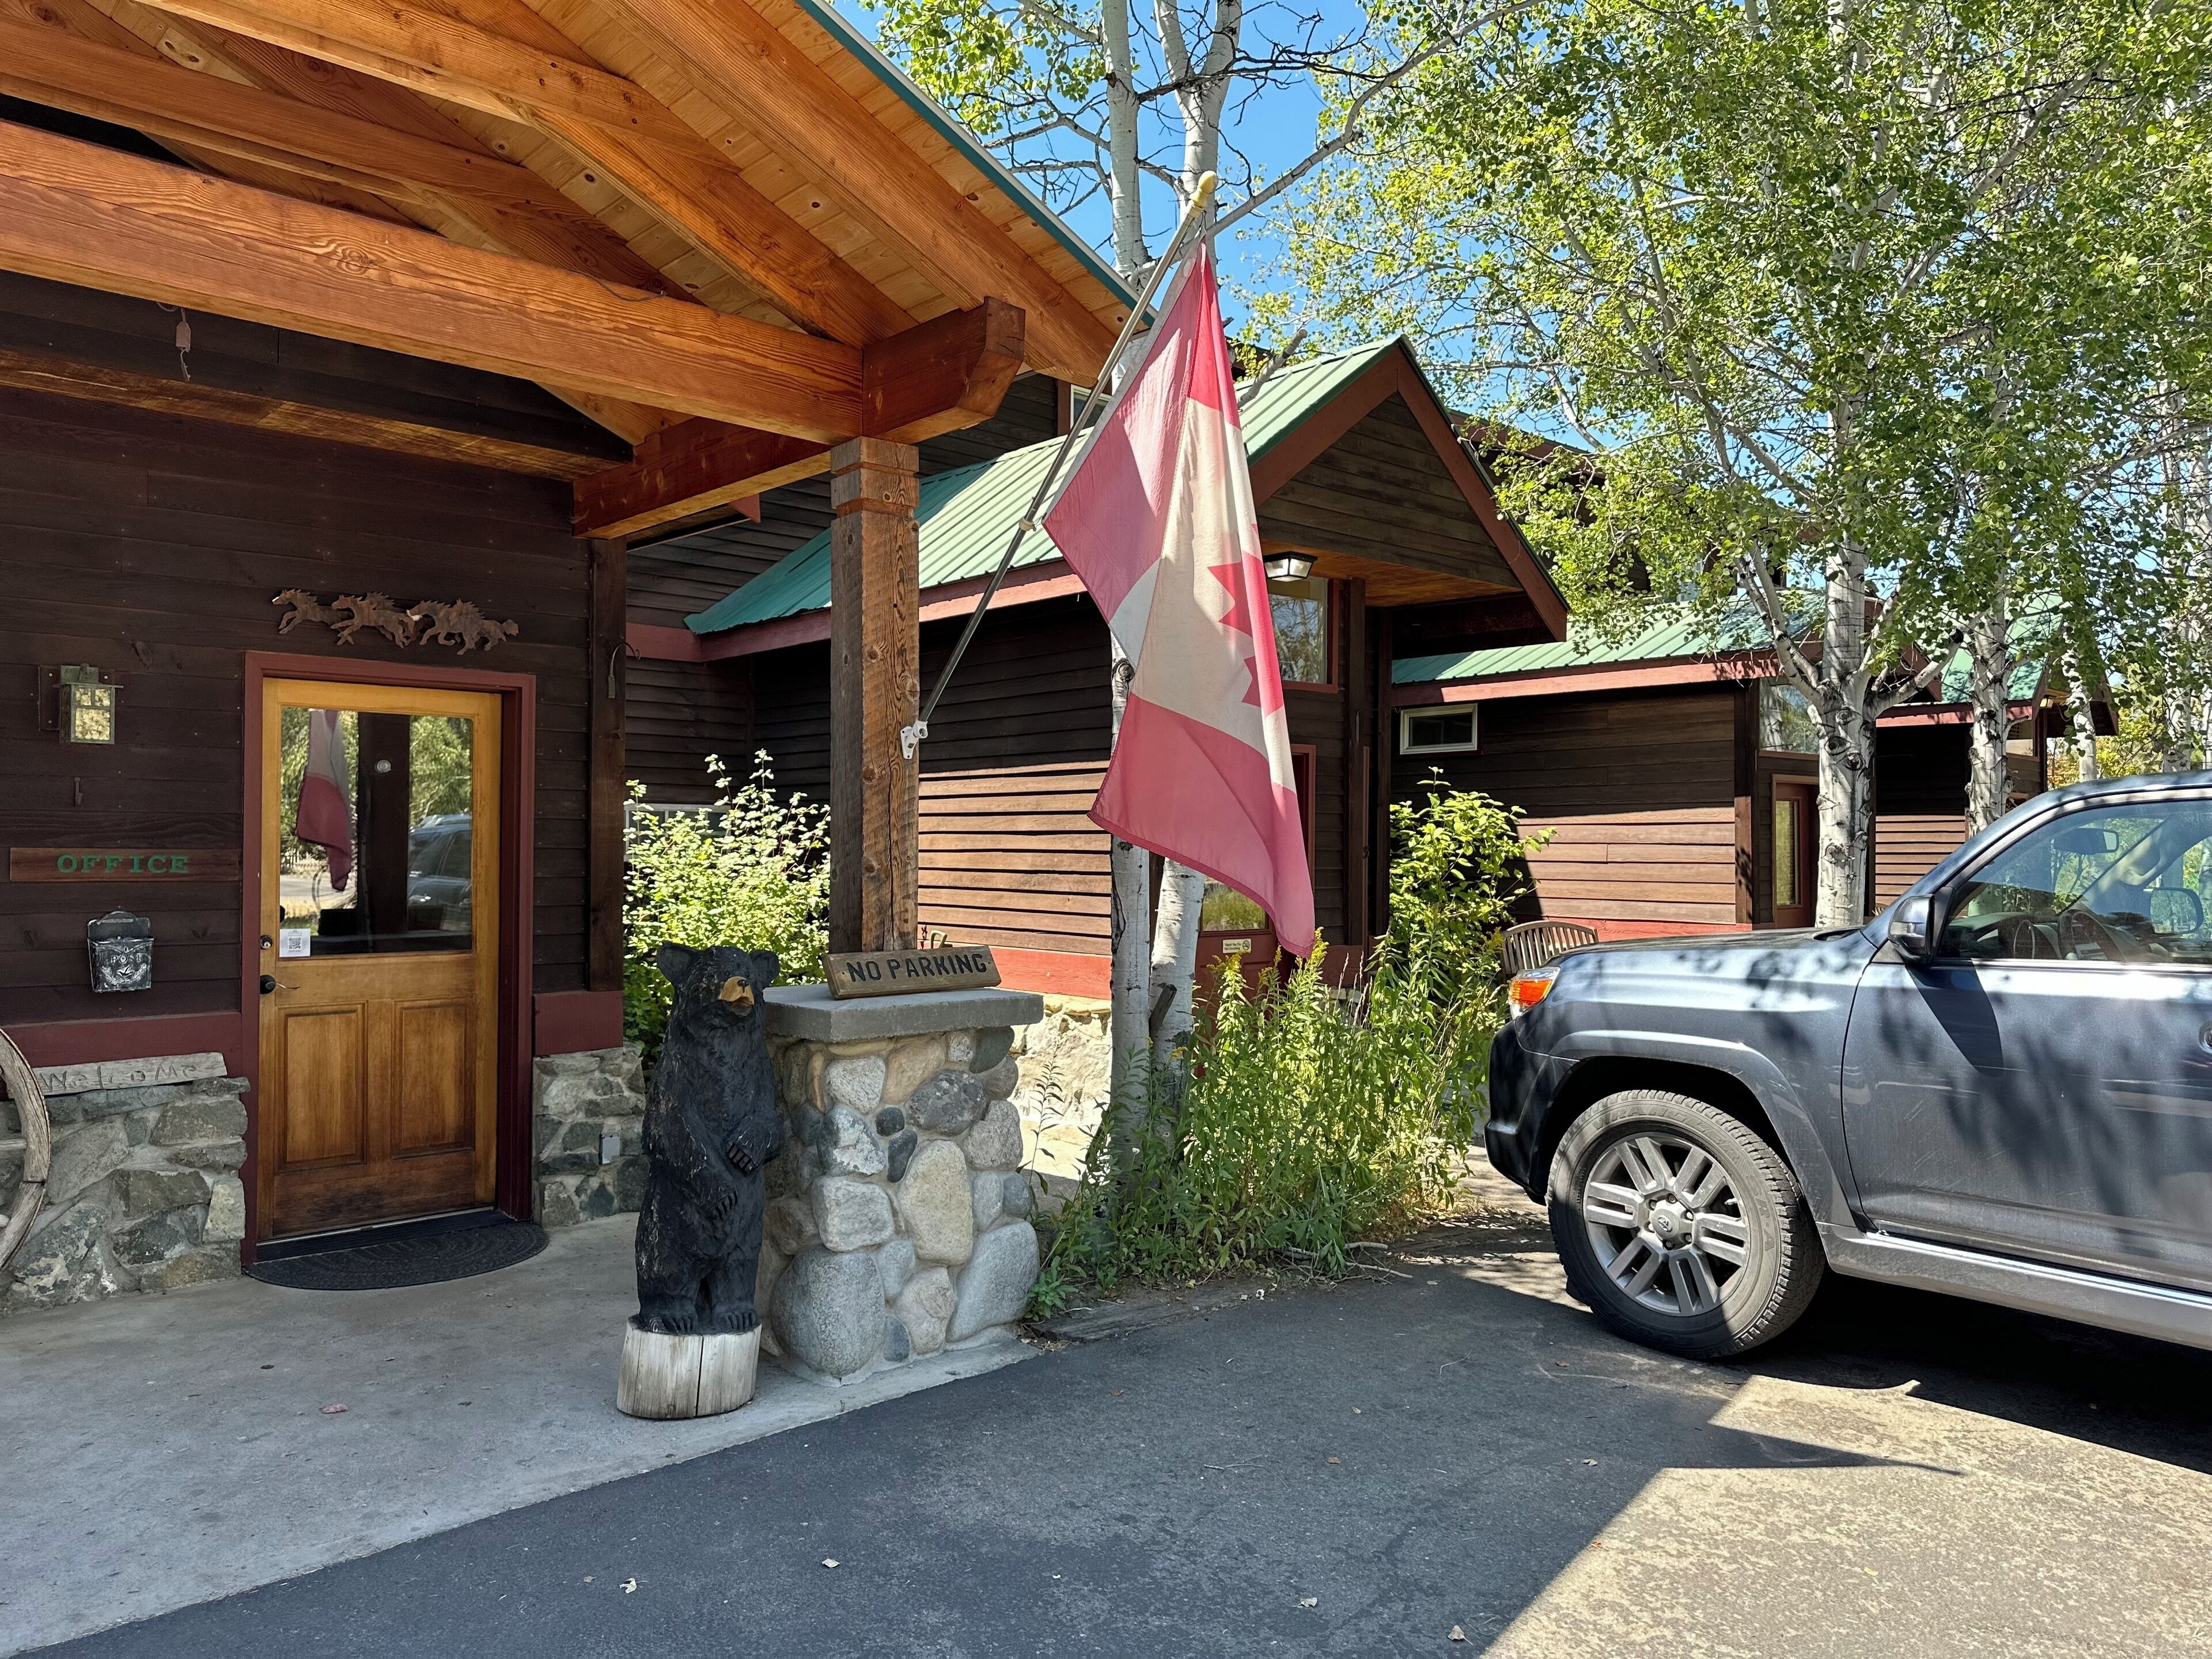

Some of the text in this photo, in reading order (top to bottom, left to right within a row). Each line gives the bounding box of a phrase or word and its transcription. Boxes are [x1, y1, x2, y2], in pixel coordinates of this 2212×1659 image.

[57, 854, 189, 873] OFFICE
[111, 953, 143, 964] POST
[846, 953, 987, 982] NO PARKING
[1593, 1106, 1740, 1161] WRANGLER
